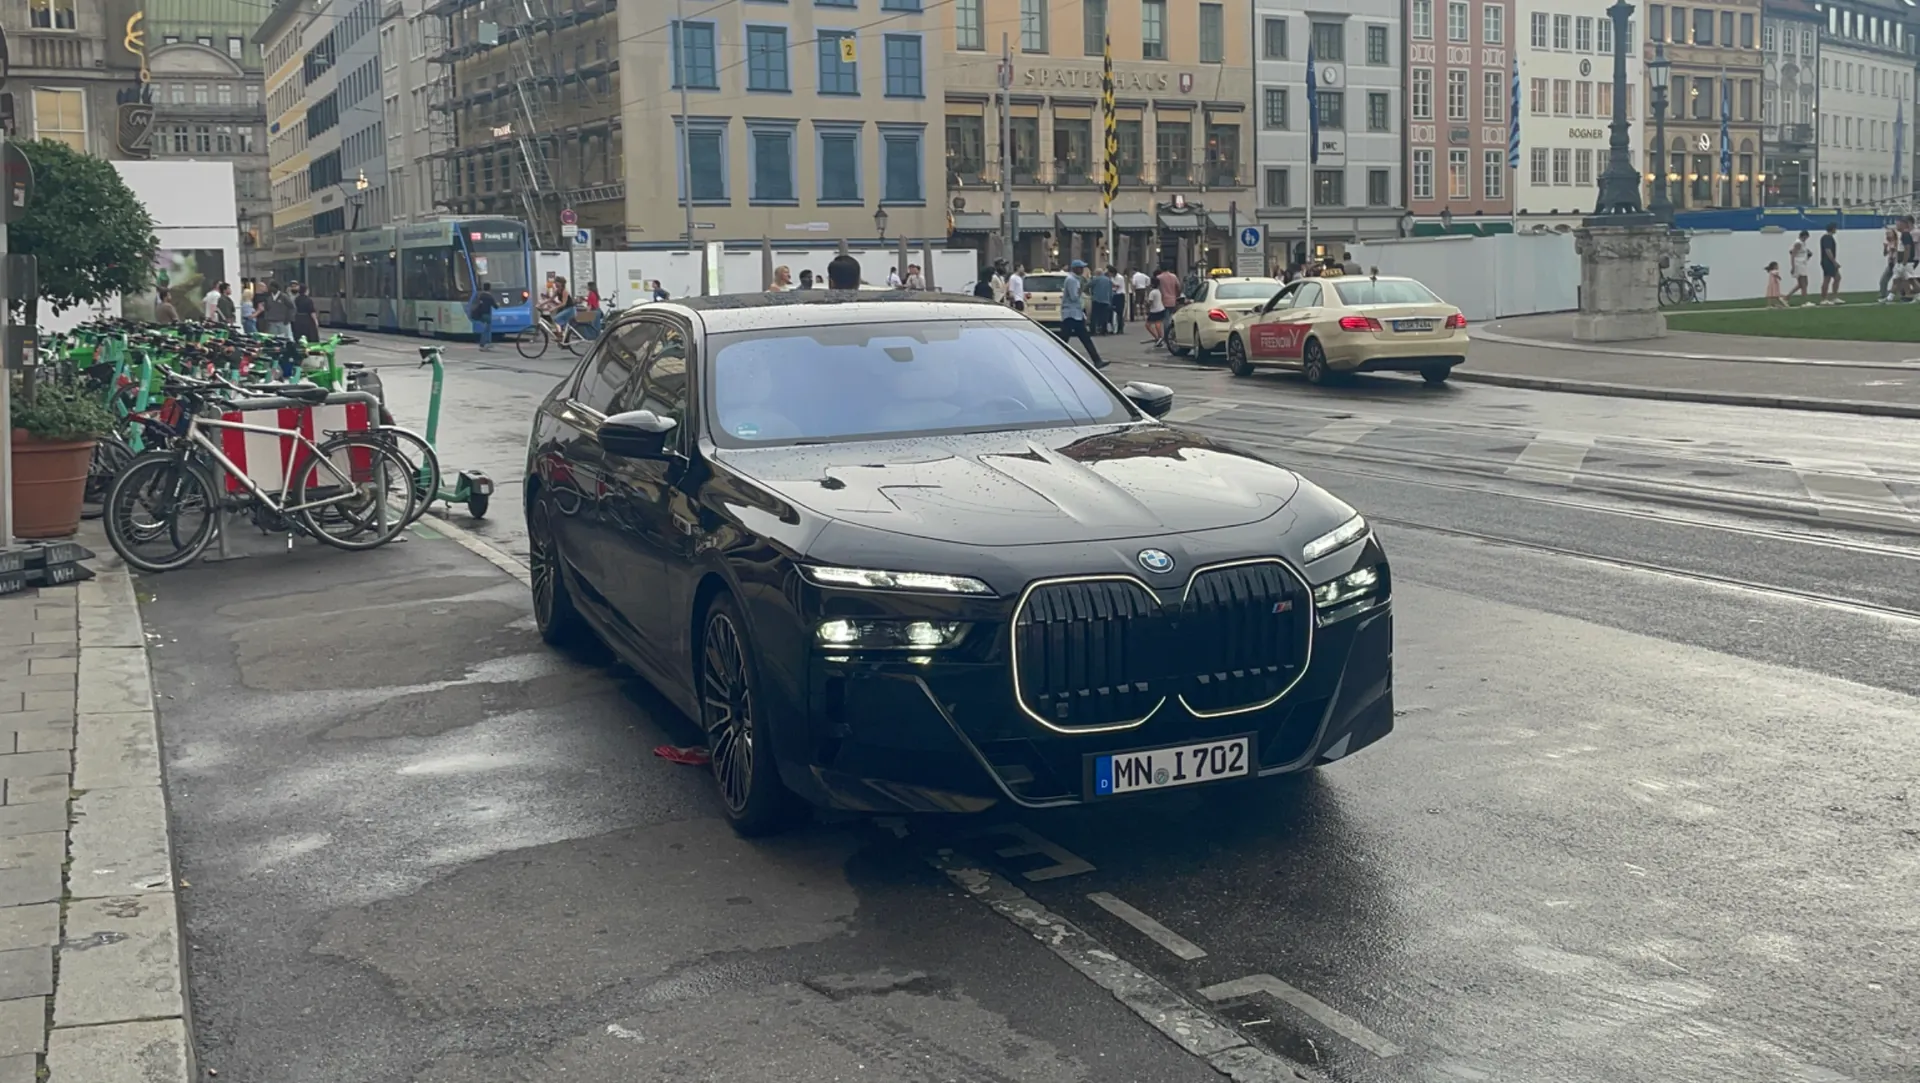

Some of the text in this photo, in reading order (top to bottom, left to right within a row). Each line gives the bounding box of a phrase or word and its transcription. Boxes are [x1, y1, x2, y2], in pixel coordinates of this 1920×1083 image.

[845, 44, 853, 56] 2
[1568, 127, 1604, 139] BOGNER
[1322, 141, 1338, 151] IWC
[53, 567, 75, 583] WH
[1101, 742, 1244, 788] D MN I 702
